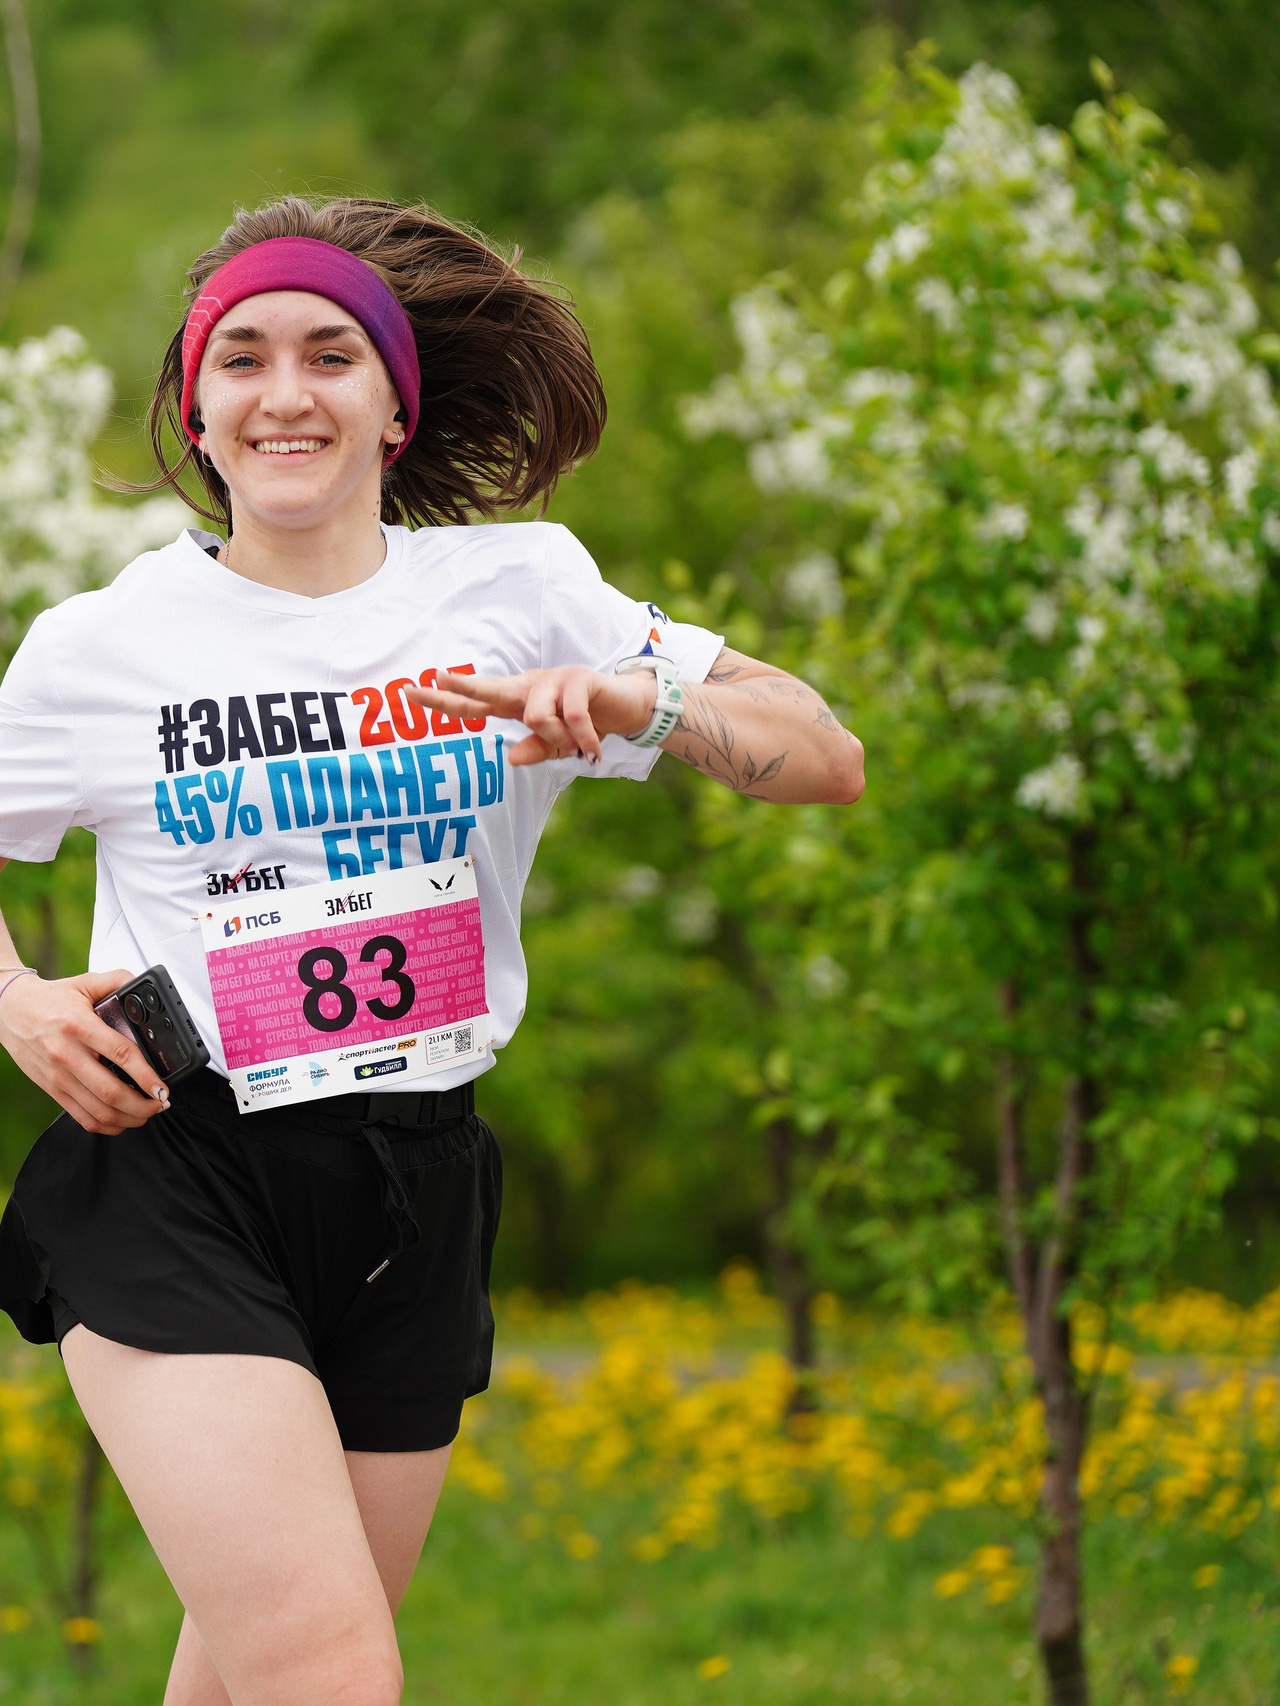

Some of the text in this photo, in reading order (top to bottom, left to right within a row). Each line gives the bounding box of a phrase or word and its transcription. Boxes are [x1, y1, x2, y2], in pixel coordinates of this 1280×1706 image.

[154, 734, 504, 846] 45% ПЛАНЕТЫ
[245, 910, 281, 929] ПСБ
[247, 956, 259, 970] НА
[259, 950, 290, 967] СТАРТЕ
[427, 917, 456, 934] ФИНИШ
[265, 937, 277, 950] ЗА
[277, 931, 306, 947] РАМКИ
[226, 988, 255, 1007] ДАВНО
[254, 982, 286, 999] ОТСТАЛ
[354, 963, 382, 980] РАМКИ
[429, 942, 479, 965] ПЕРЕЗАГРУЗКА
[228, 975, 244, 989] БЕГ
[244, 973, 251, 985] В
[250, 969, 272, 984] СЕБЕ
[416, 935, 436, 952] ПОКА
[436, 931, 450, 947] ВСЕ
[450, 927, 468, 944] СПЯТ
[298, 935, 415, 1033] 83
[245, 1000, 279, 1017] ТОЛЬКО
[426, 966, 445, 982] ВСЕМ
[445, 959, 476, 978] СЕРДЦЕМ
[254, 1015, 279, 1031] ЛЮБИ
[280, 1012, 296, 1026] БЕГ
[296, 1010, 303, 1022] В
[458, 974, 475, 989] ПОКА
[265, 1026, 298, 1044] СТРЕСС
[420, 997, 443, 1013] РАМКИ
[455, 988, 482, 1004] БЕГОВАЯ
[263, 1042, 298, 1061] ФИНИШ
[307, 1034, 340, 1053] ТОЛЬКО
[341, 1028, 372, 1046] НАЧАЛО
[384, 1024, 395, 1037] НА
[395, 1018, 422, 1035] СТАРТЕ
[422, 1012, 447, 1029] ЖИЗНИ
[457, 1005, 472, 1020] БЕГУ
[397, 1038, 416, 1049] PRO
[246, 1064, 288, 1082] СИБУР
[248, 1076, 290, 1093] ФОРМУЛА
